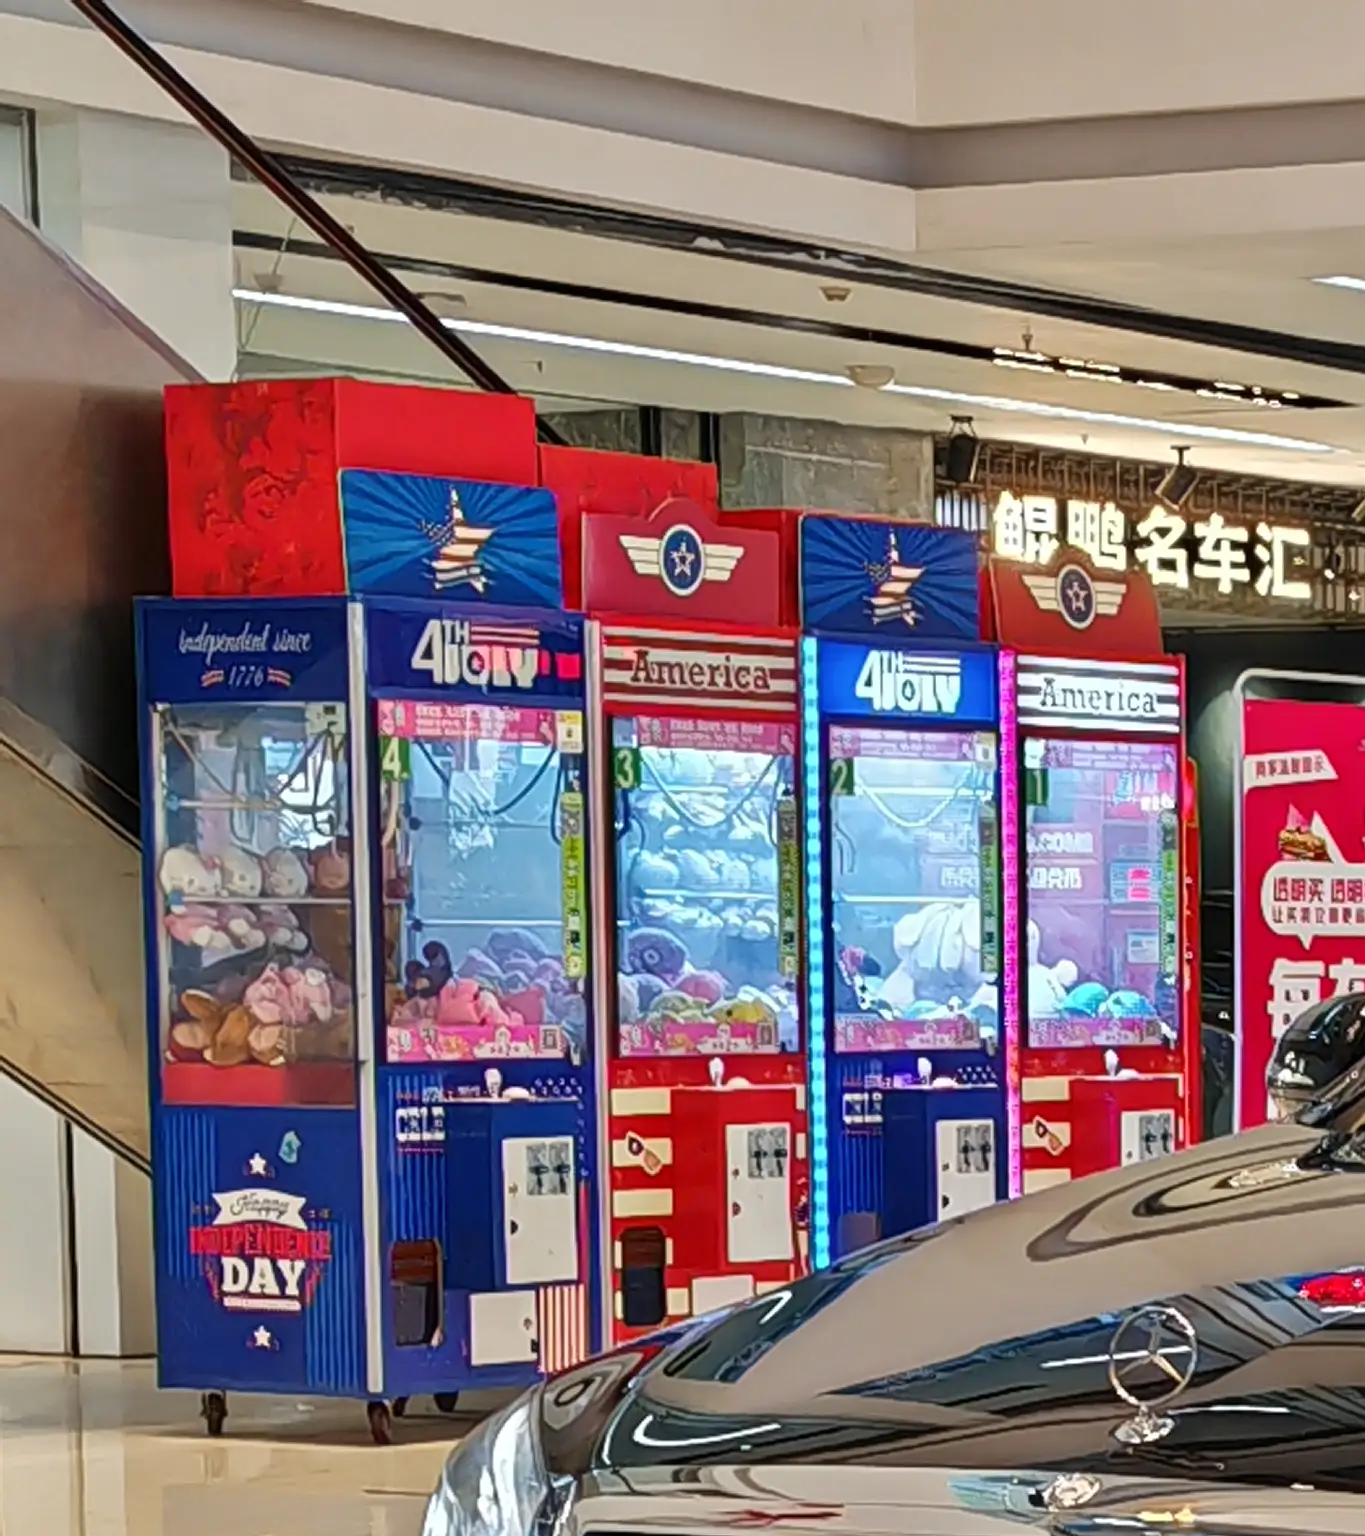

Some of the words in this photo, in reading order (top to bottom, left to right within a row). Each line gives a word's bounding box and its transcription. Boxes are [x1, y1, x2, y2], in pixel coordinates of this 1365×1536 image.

[993, 489, 1312, 600] 鲲鹏名车汇
[630, 649, 771, 691] America
[1040, 676, 1158, 714] America
[220, 1255, 306, 1296] DAY
